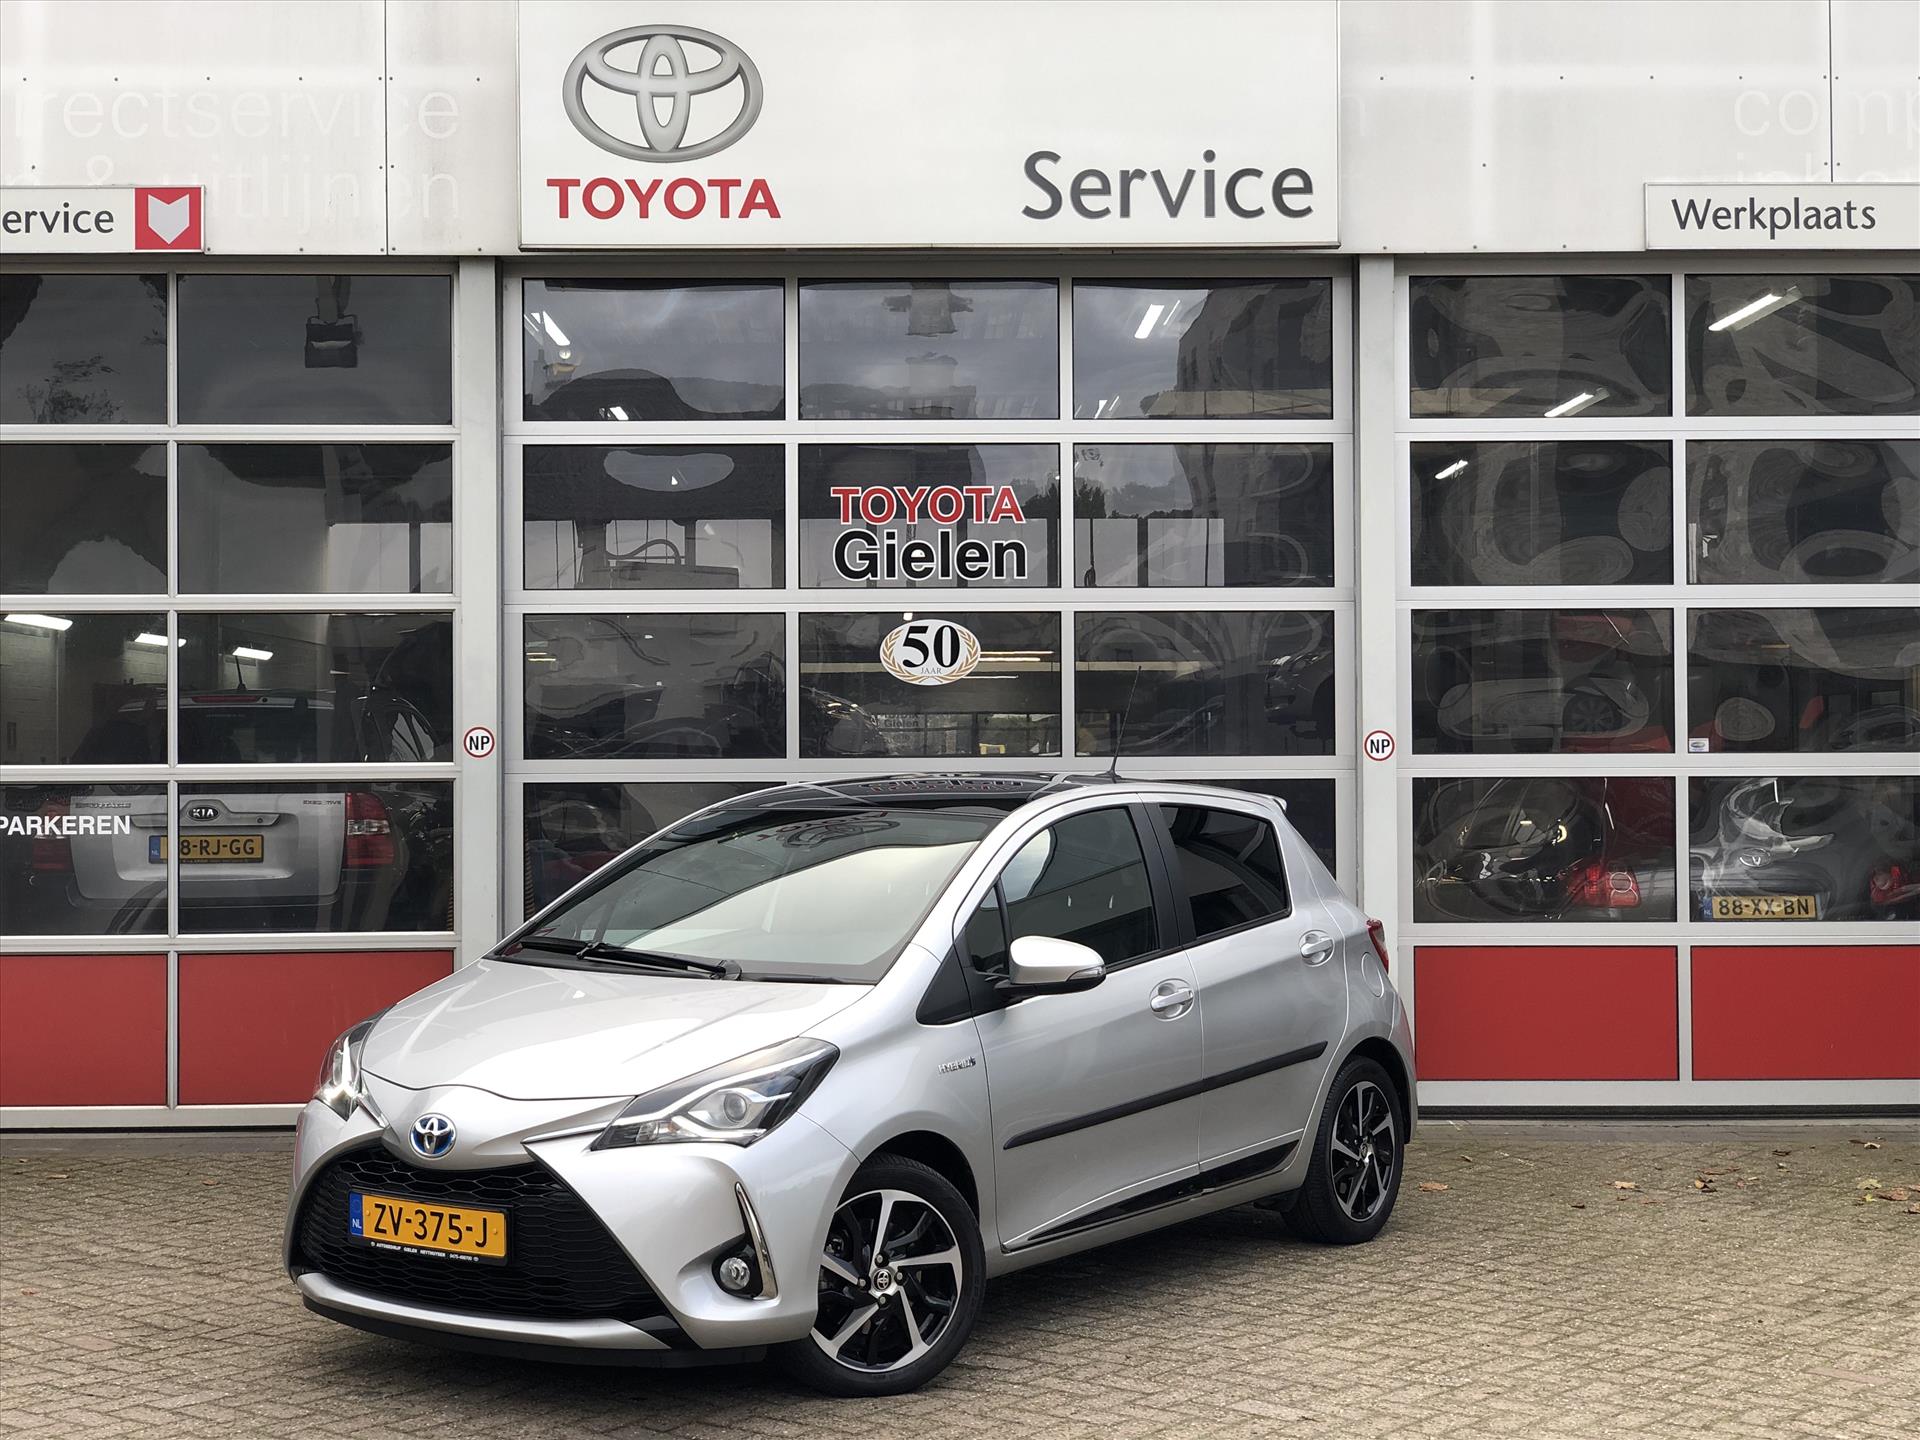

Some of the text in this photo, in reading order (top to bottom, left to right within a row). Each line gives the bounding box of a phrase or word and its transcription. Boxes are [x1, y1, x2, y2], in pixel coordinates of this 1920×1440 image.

[547, 178, 781, 219] TOYOTA
[1021, 150, 1314, 219] Service
[2, 202, 114, 234] ervice
[1671, 197, 1876, 240] Werkplaats
[831, 486, 1026, 525] TOYOTA
[833, 529, 1028, 581] Gielen
[902, 625, 961, 668] 50
[920, 667, 942, 675] JAAR
[469, 735, 491, 751] NP
[1370, 739, 1391, 754] NP
[192, 807, 215, 818] KIA
[180, 838, 255, 856] 8-RJ-GG
[1719, 898, 1809, 916] 88-XX-BN
[352, 1203, 487, 1248] NL ZV-375-J
